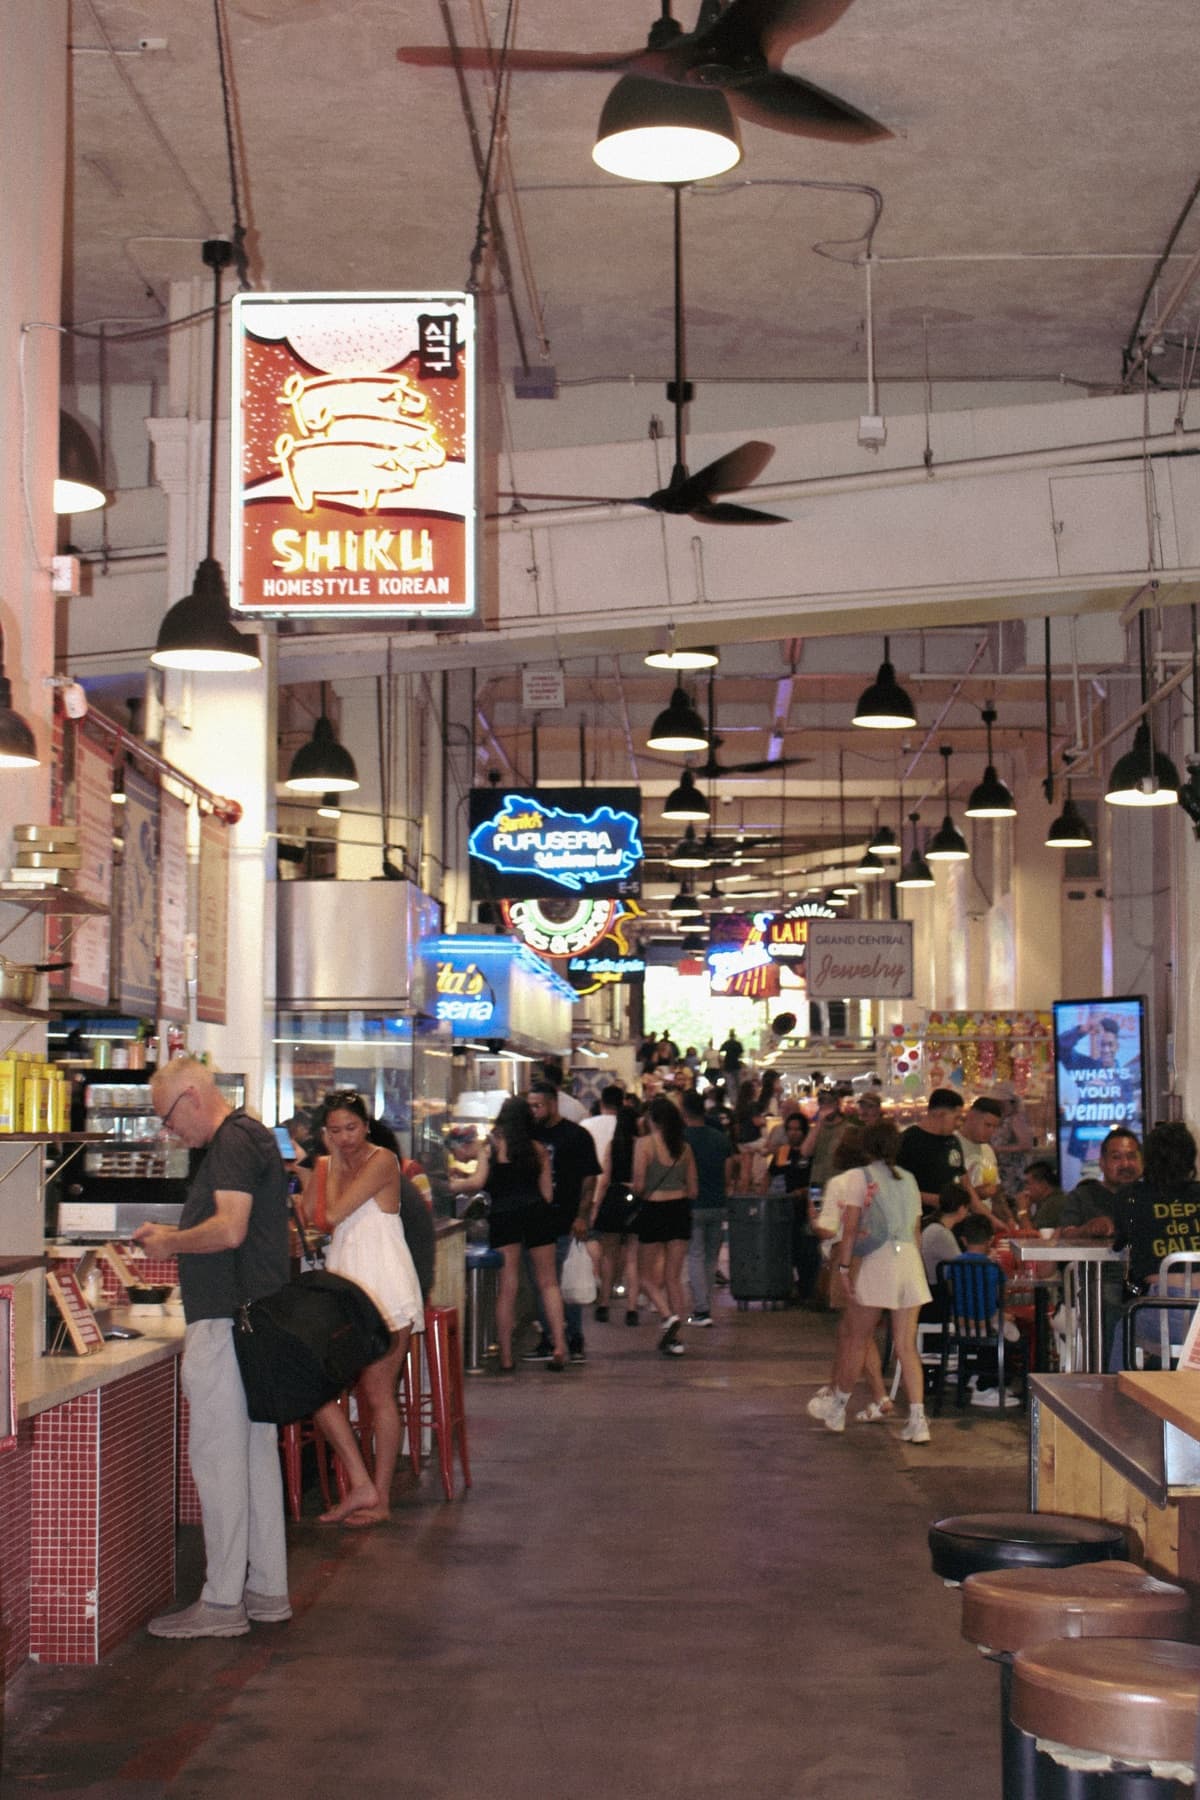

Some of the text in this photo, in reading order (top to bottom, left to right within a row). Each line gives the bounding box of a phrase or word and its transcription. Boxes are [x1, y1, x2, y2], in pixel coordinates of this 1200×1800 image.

[424, 321, 452, 372] 식구
[271, 528, 434, 573] SHIKU
[263, 576, 450, 597] HOMESTYLE KOREAN
[492, 830, 613, 852] PUPUSERIA
[815, 934, 905, 946] GRAND CENTRAL
[815, 953, 906, 989] Jewelry
[1072, 1067, 1131, 1081] WHAT'S
[1079, 1085, 1122, 1099] YOUR
[1063, 1102, 1137, 1121] venmo?
[1166, 1219, 1190, 1236] de
